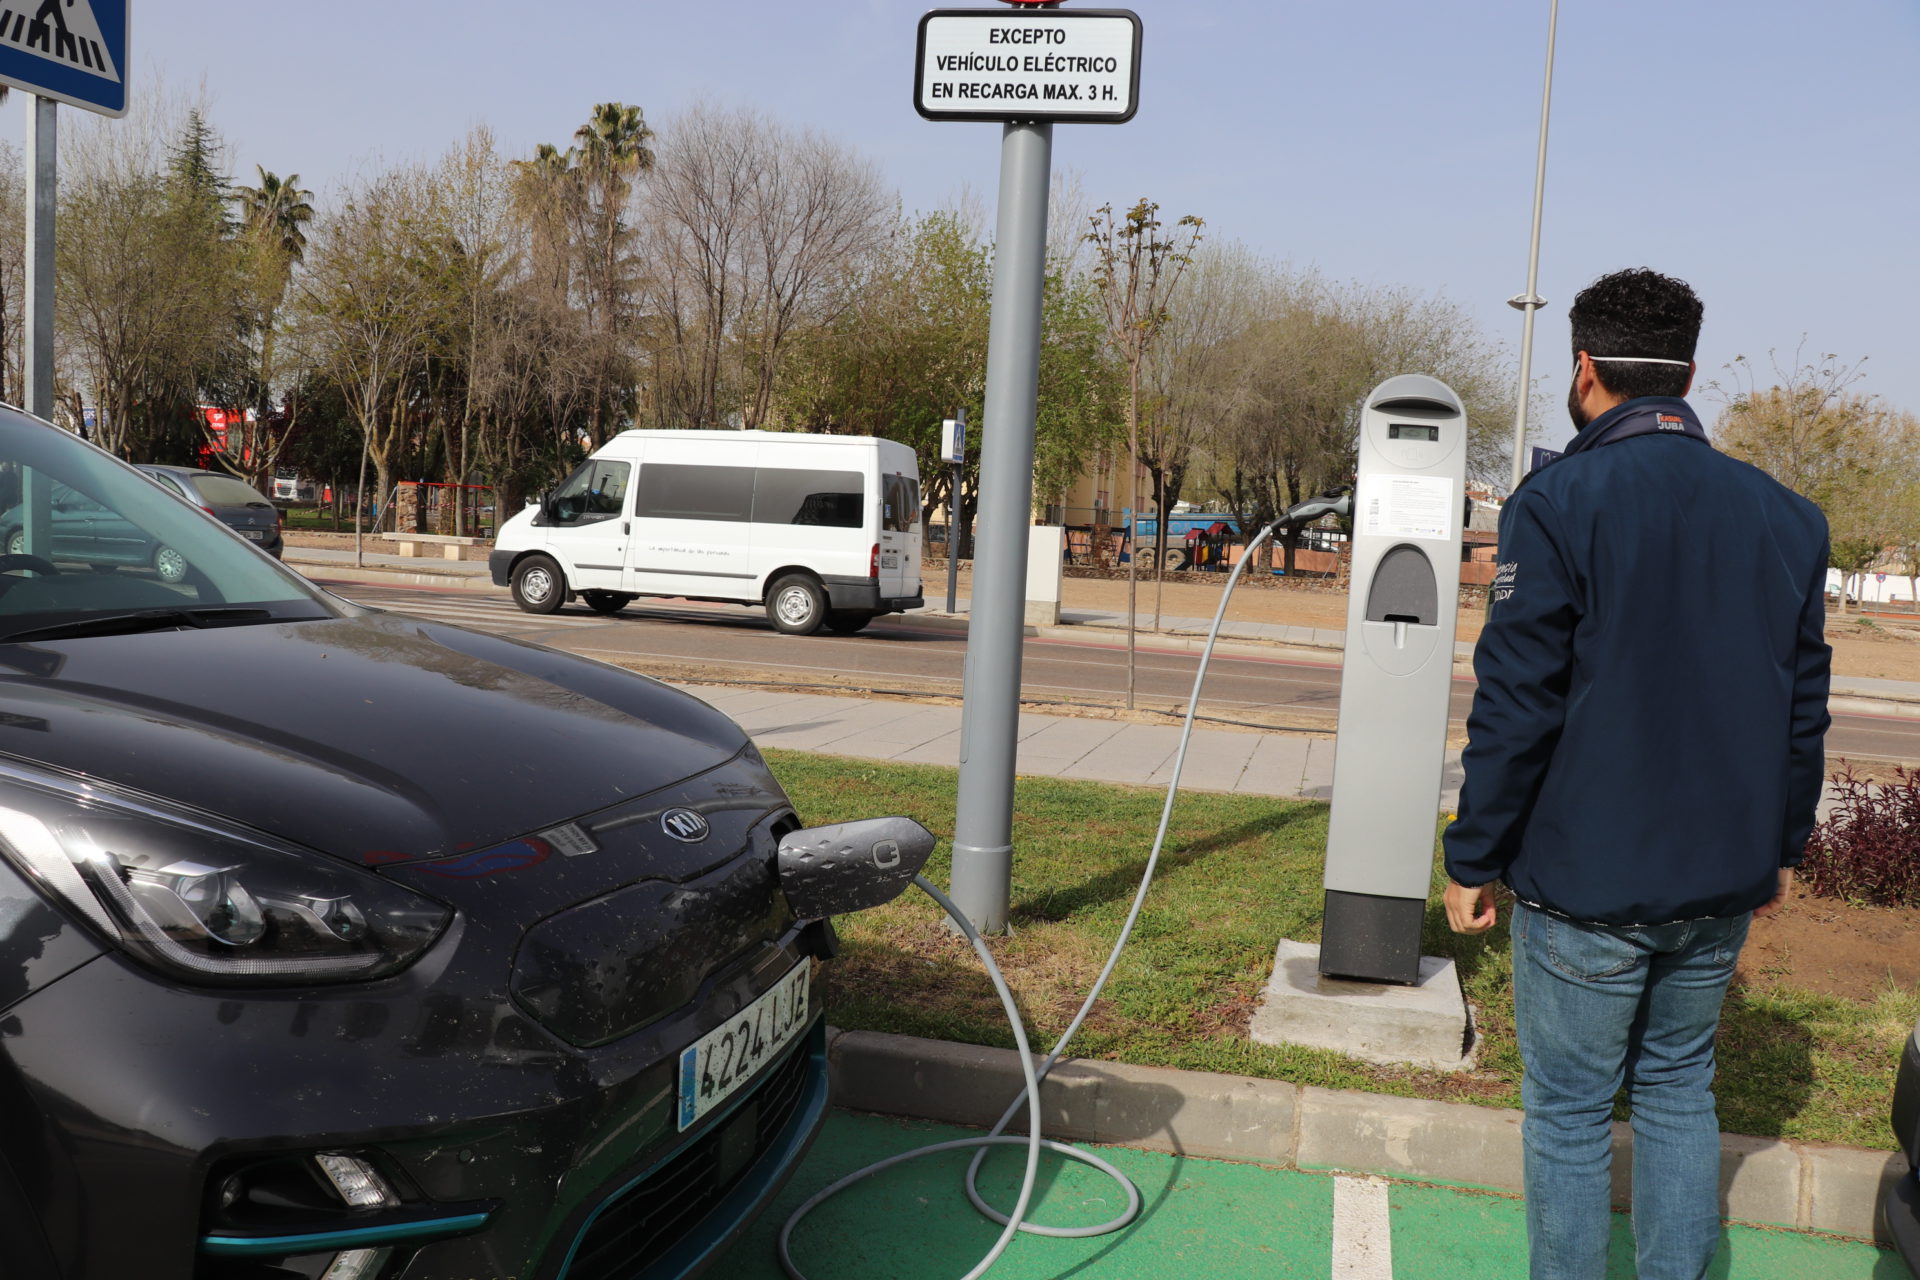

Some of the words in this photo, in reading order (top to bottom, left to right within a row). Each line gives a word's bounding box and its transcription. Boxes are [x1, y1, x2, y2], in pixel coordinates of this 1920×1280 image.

[989, 28, 1066, 45] EXCEPTO
[936, 51, 1019, 72] VEHÍCULO
[1023, 52, 1117, 73] ELÉCTRICO
[931, 82, 953, 98] EN
[958, 82, 1039, 100] RECARGA
[1043, 84, 1083, 100] MAX.
[1088, 85, 1097, 100] 3
[1102, 84, 1118, 101] H.
[1657, 422, 1685, 431] JUBA
[667, 811, 706, 837] KIA
[700, 1007, 764, 1099] 4224
[771, 968, 806, 1046] LJZ
